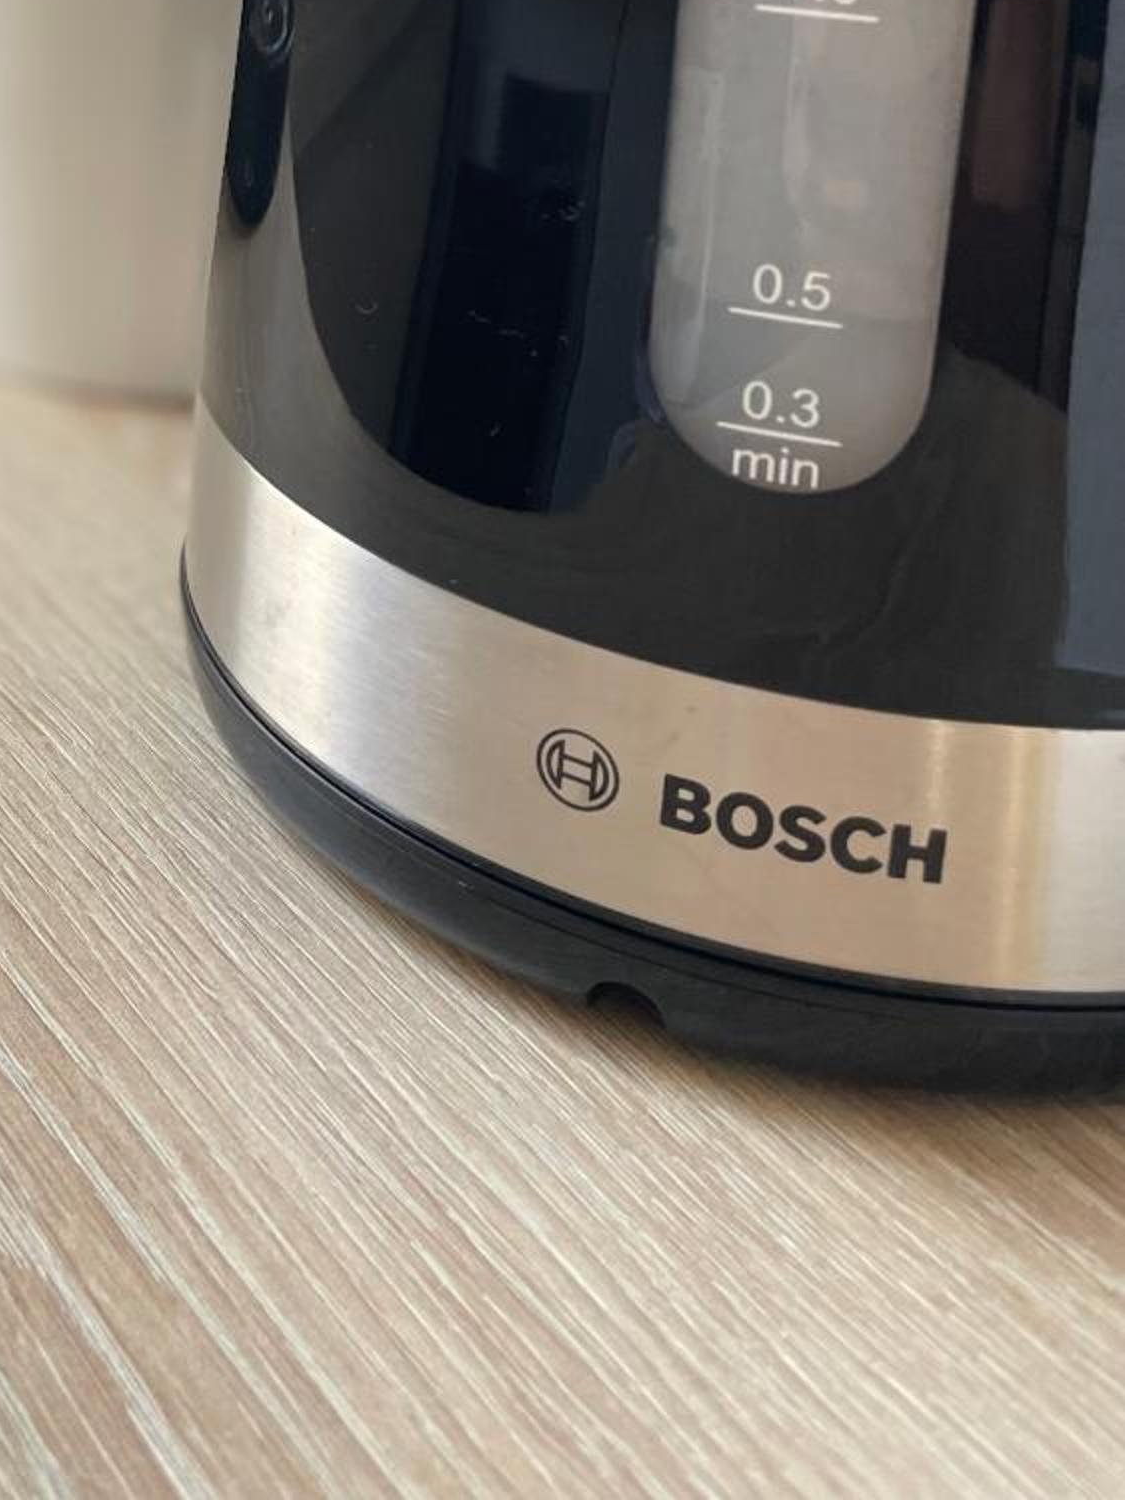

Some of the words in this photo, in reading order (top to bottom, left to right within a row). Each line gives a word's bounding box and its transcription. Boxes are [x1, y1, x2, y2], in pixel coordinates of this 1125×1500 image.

[752, 263, 832, 311] 0.5
[741, 380, 821, 428] 0.3
[731, 446, 820, 490] min
[659, 772, 948, 884] BOSCH
